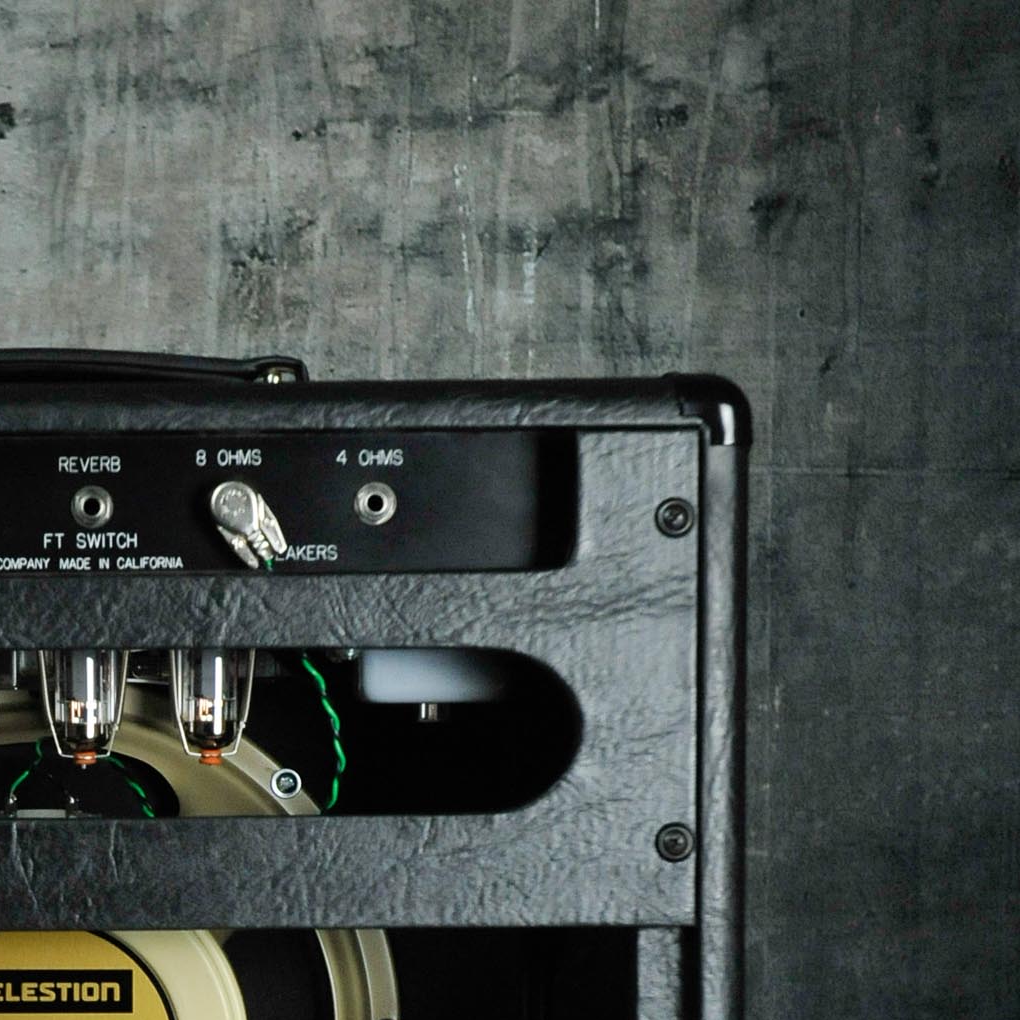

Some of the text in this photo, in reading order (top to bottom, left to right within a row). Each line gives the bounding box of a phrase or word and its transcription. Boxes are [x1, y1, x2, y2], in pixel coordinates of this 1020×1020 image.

[58, 456, 122, 473] REVERB
[196, 449, 262, 467] 8 OHMS
[335, 449, 404, 467] 4 OHMS
[43, 532, 138, 549] FT SWITCH
[275, 545, 339, 562] AKERS
[59, 556, 92, 570] MADE
[99, 557, 110, 570] IN
[116, 556, 184, 570] CALIFORNIA
